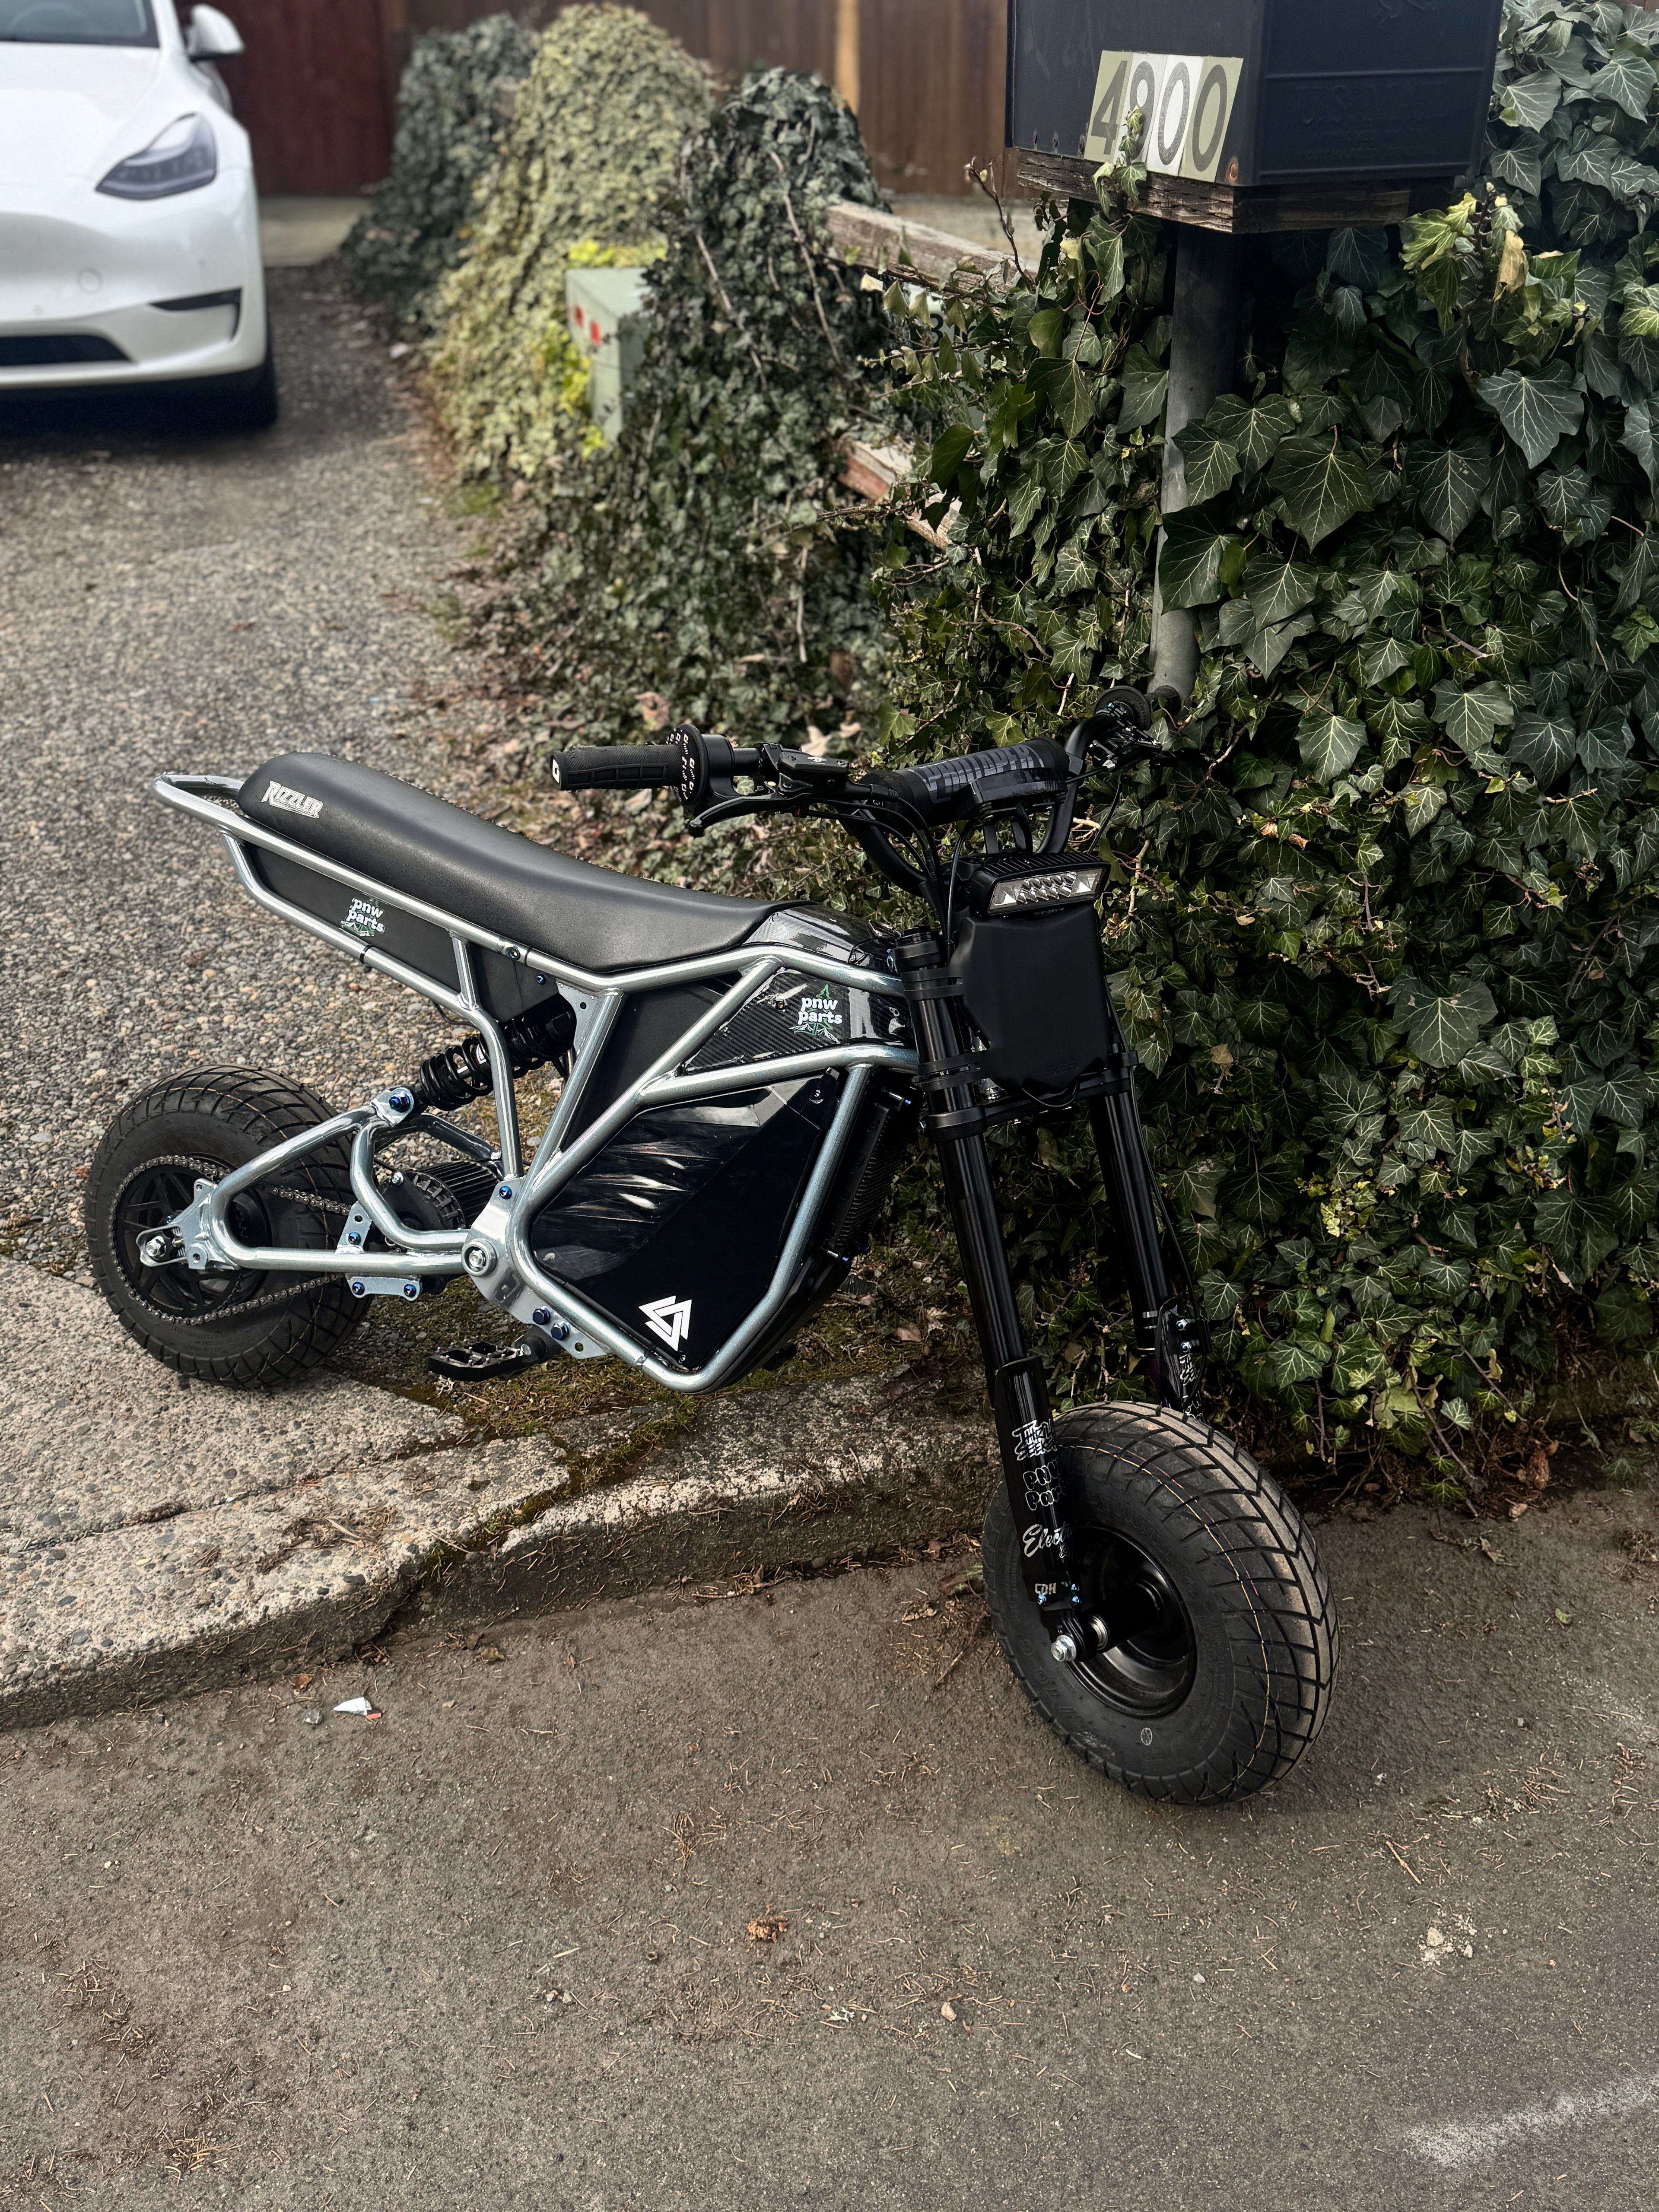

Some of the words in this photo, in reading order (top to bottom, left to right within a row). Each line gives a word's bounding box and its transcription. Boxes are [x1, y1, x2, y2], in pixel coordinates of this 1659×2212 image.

[1091, 60, 1227, 172] 4900
[261, 780, 324, 818] RIZZLER
[353, 898, 384, 918] pnw
[346, 909, 385, 933] parts
[801, 996, 838, 1011] pnw
[798, 1010, 842, 1025] parts
